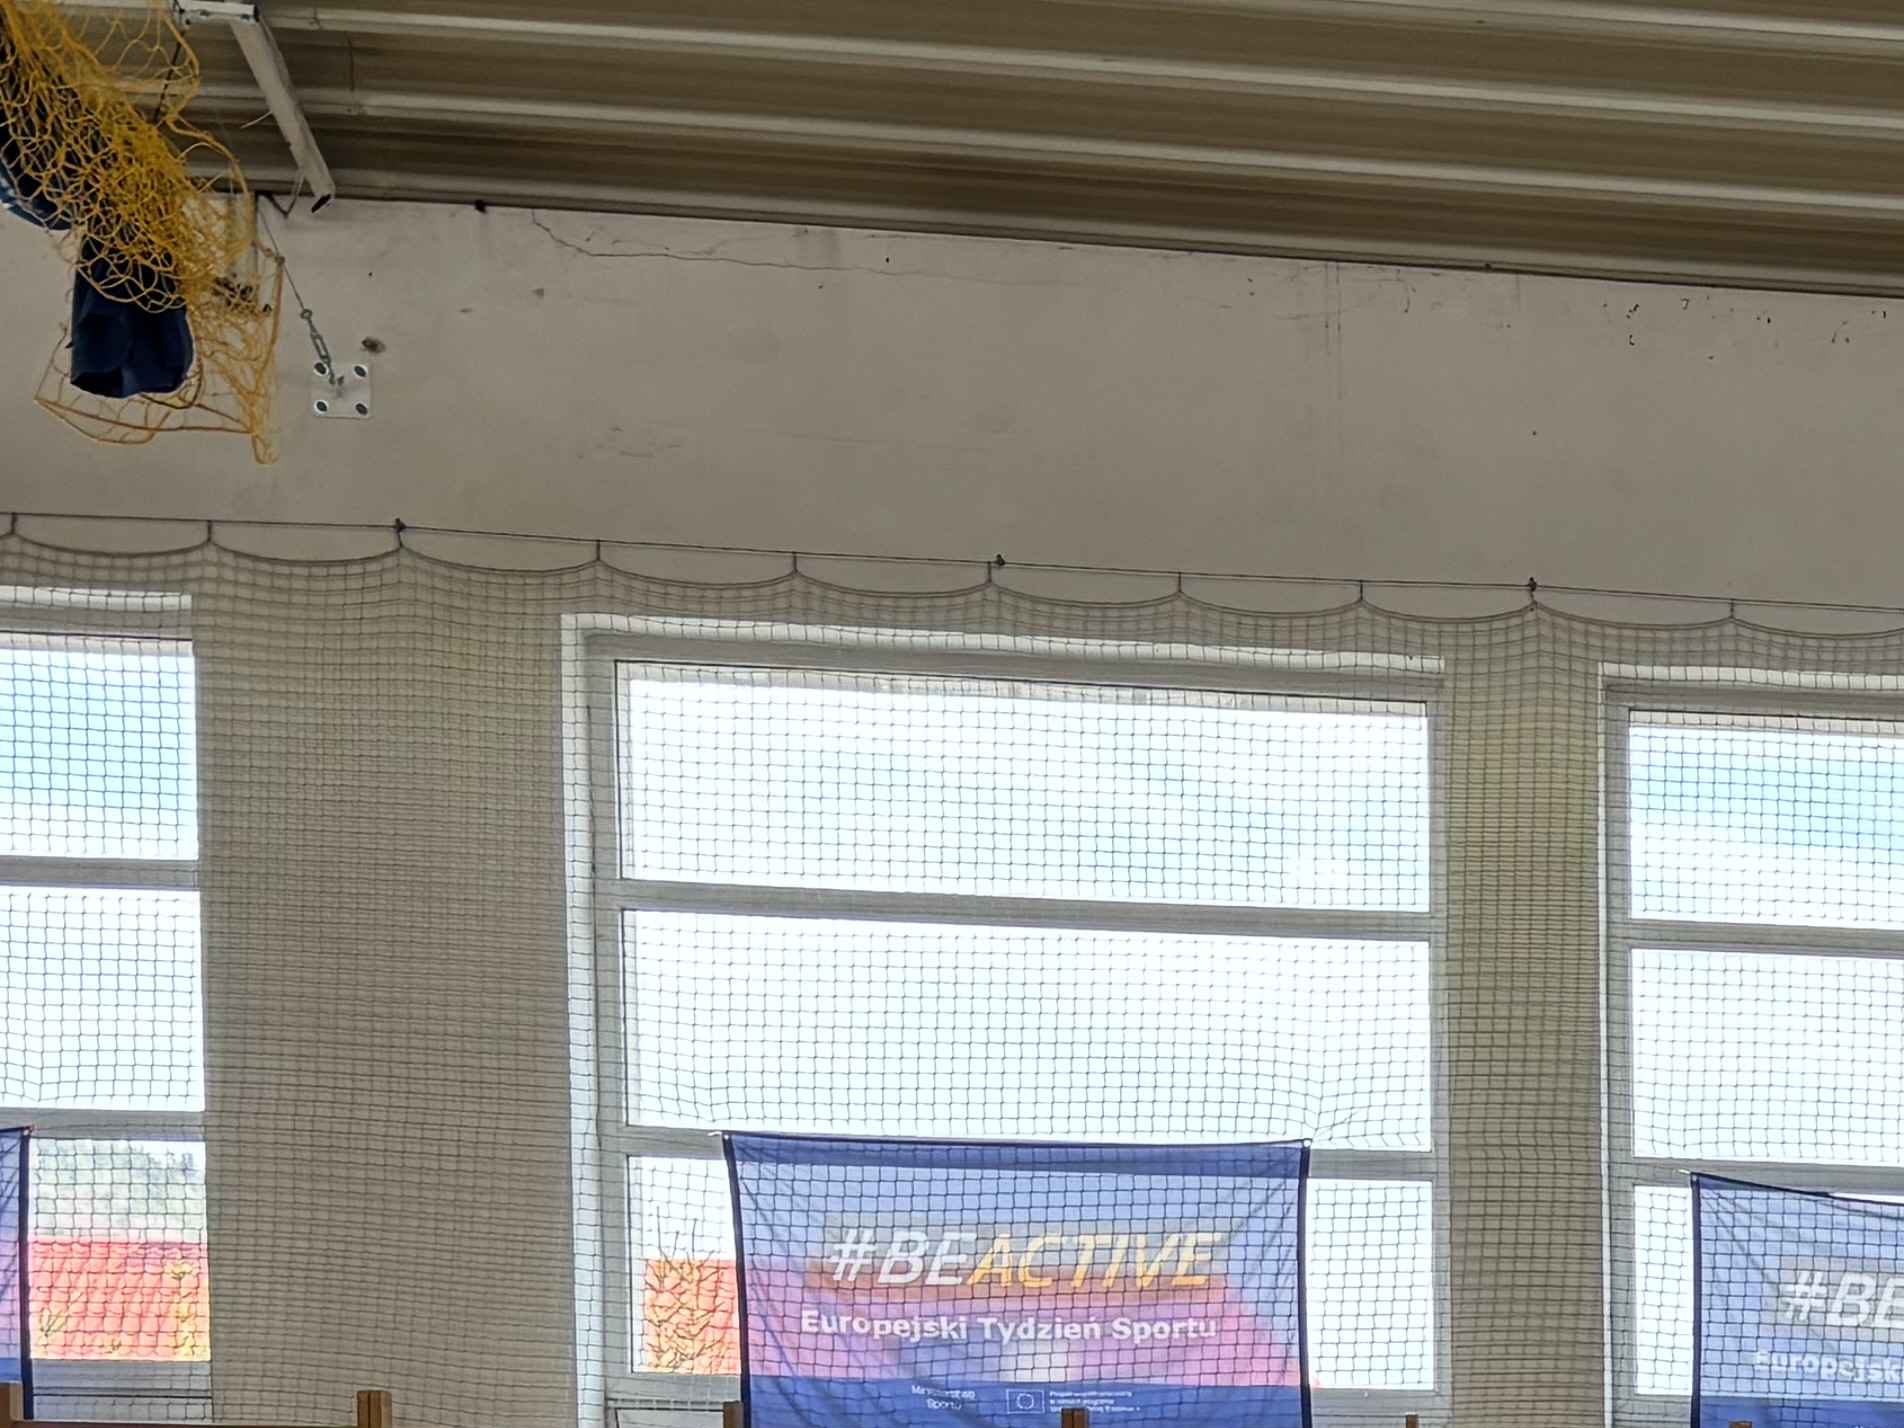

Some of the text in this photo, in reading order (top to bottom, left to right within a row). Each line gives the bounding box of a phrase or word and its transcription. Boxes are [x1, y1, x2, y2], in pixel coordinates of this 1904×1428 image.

[829, 1229, 1223, 1288] #BEACTIVE
[801, 1311, 1217, 1345] Europejski Tydzień Sportu
